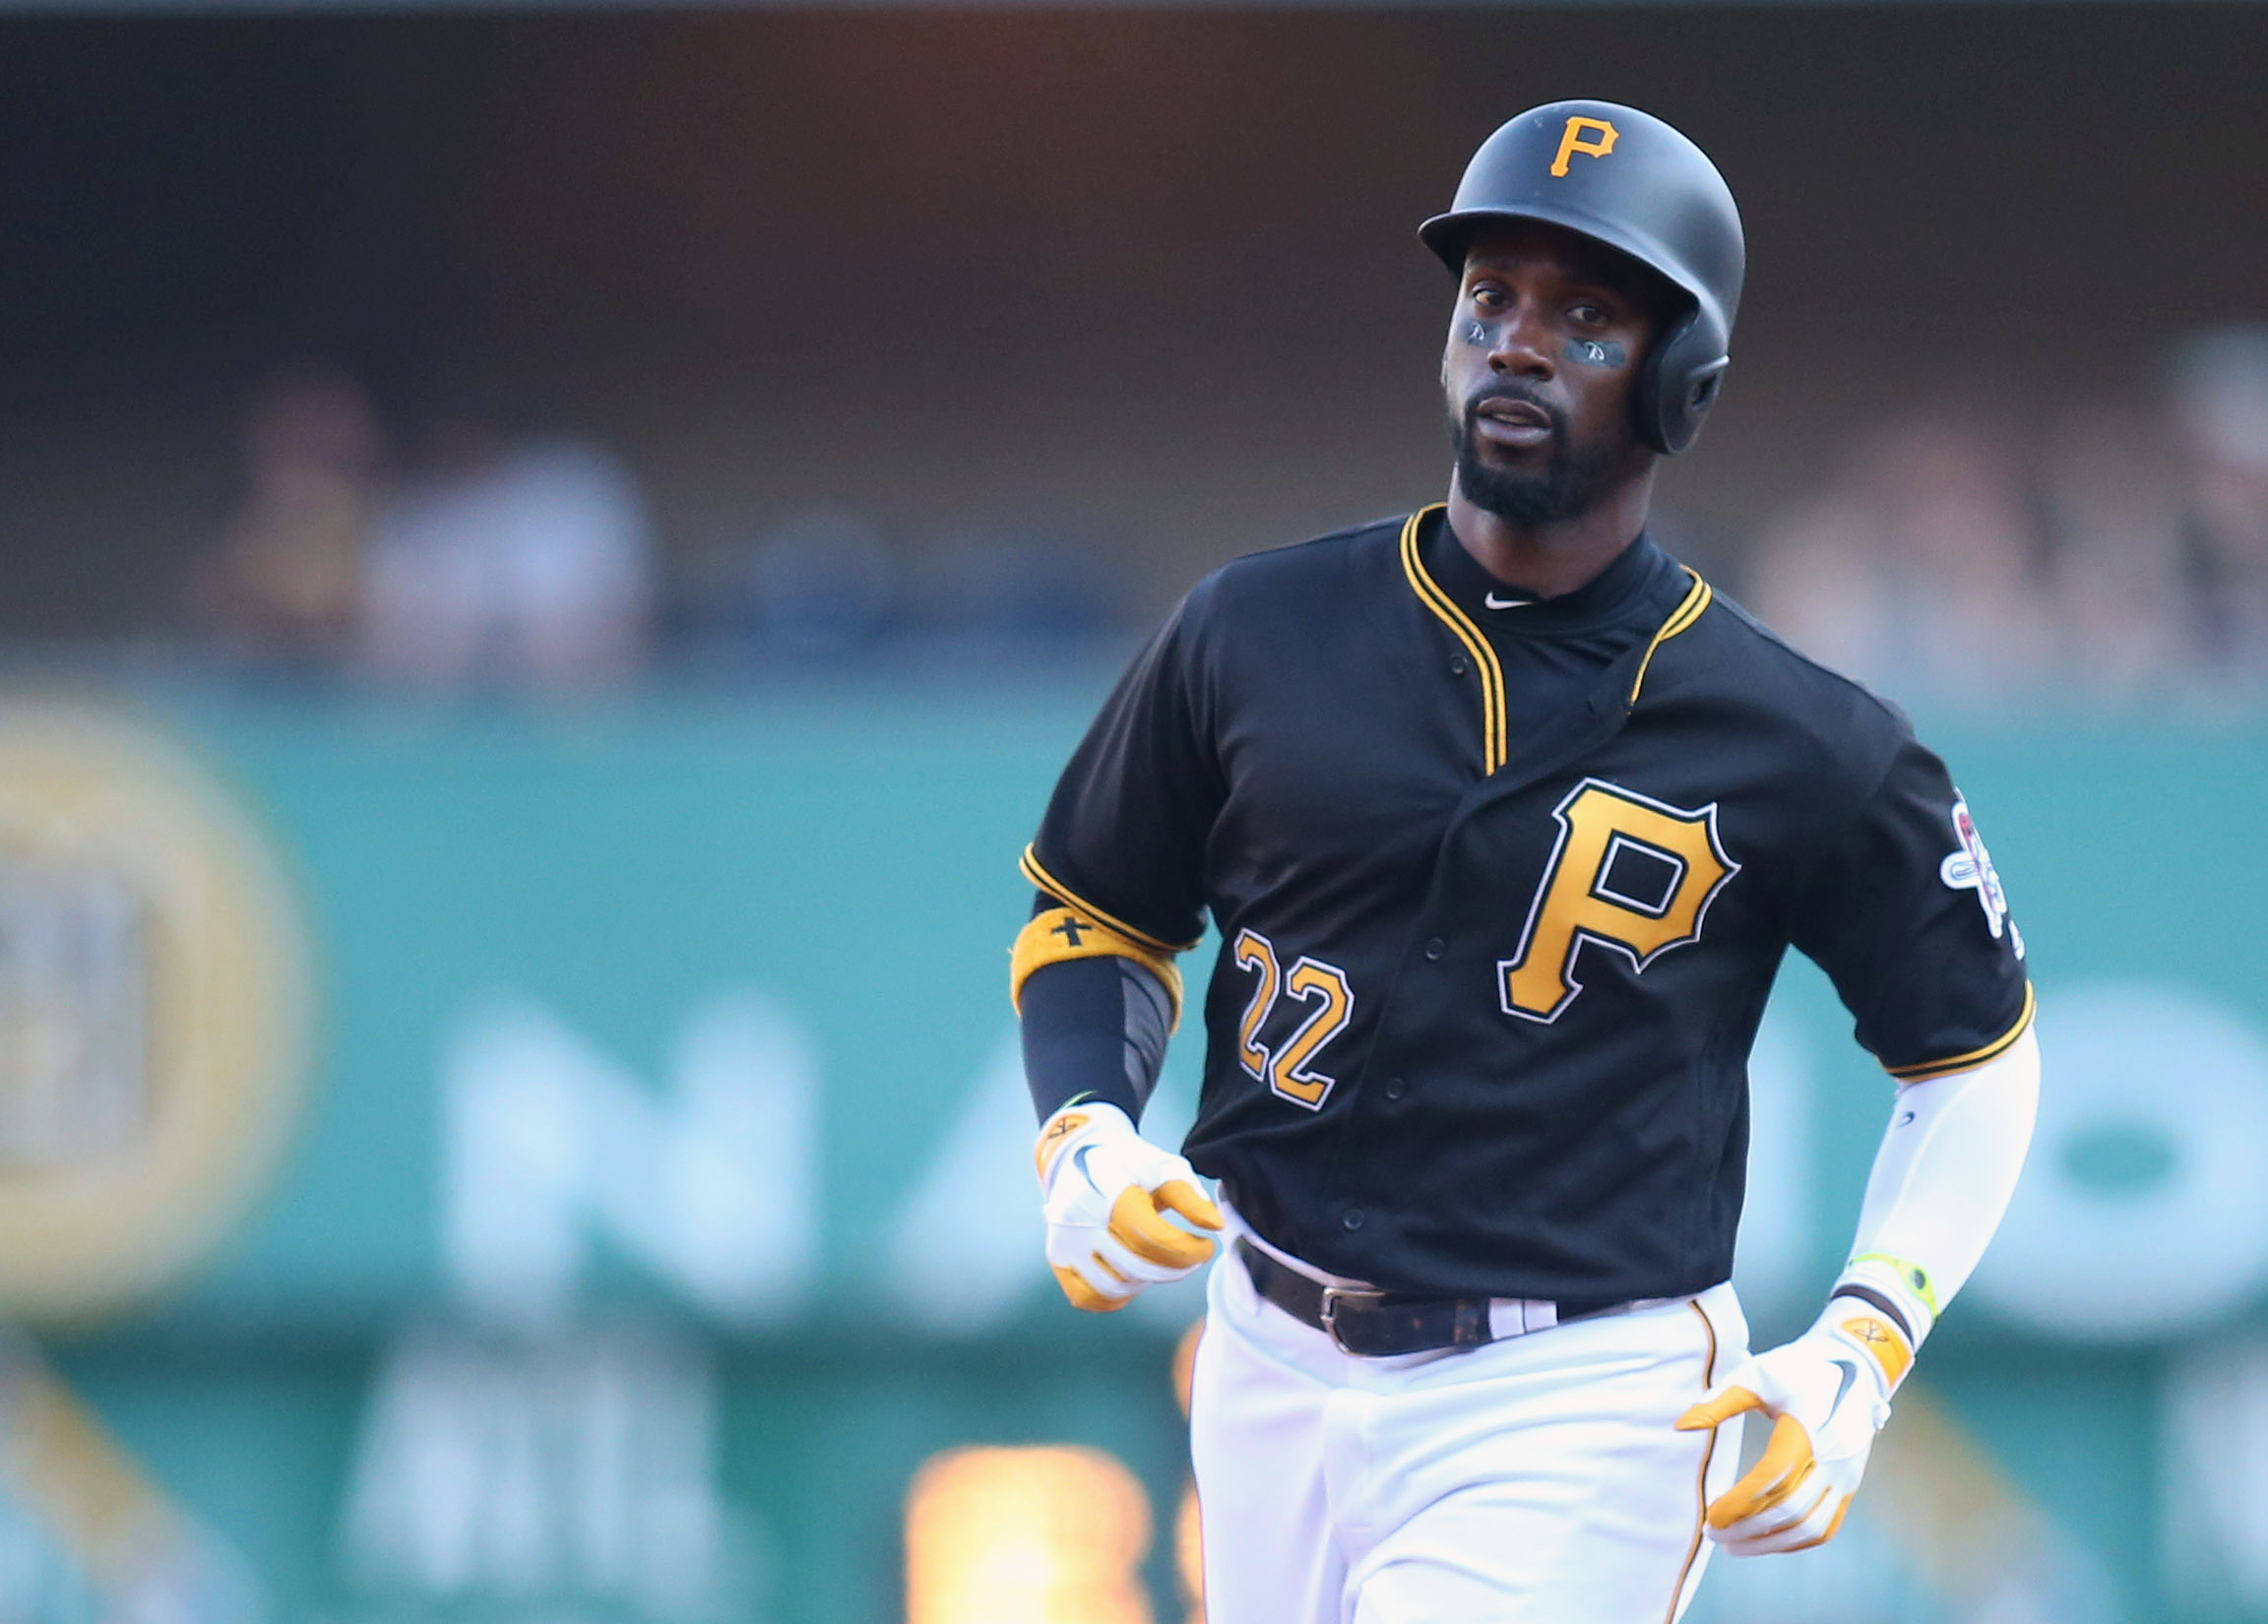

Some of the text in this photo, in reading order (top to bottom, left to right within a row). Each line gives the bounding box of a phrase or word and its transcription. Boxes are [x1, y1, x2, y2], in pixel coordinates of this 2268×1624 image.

[1549, 116, 1620, 178] P
[1496, 777, 1742, 1025] P
[1233, 926, 1355, 1112] 22
